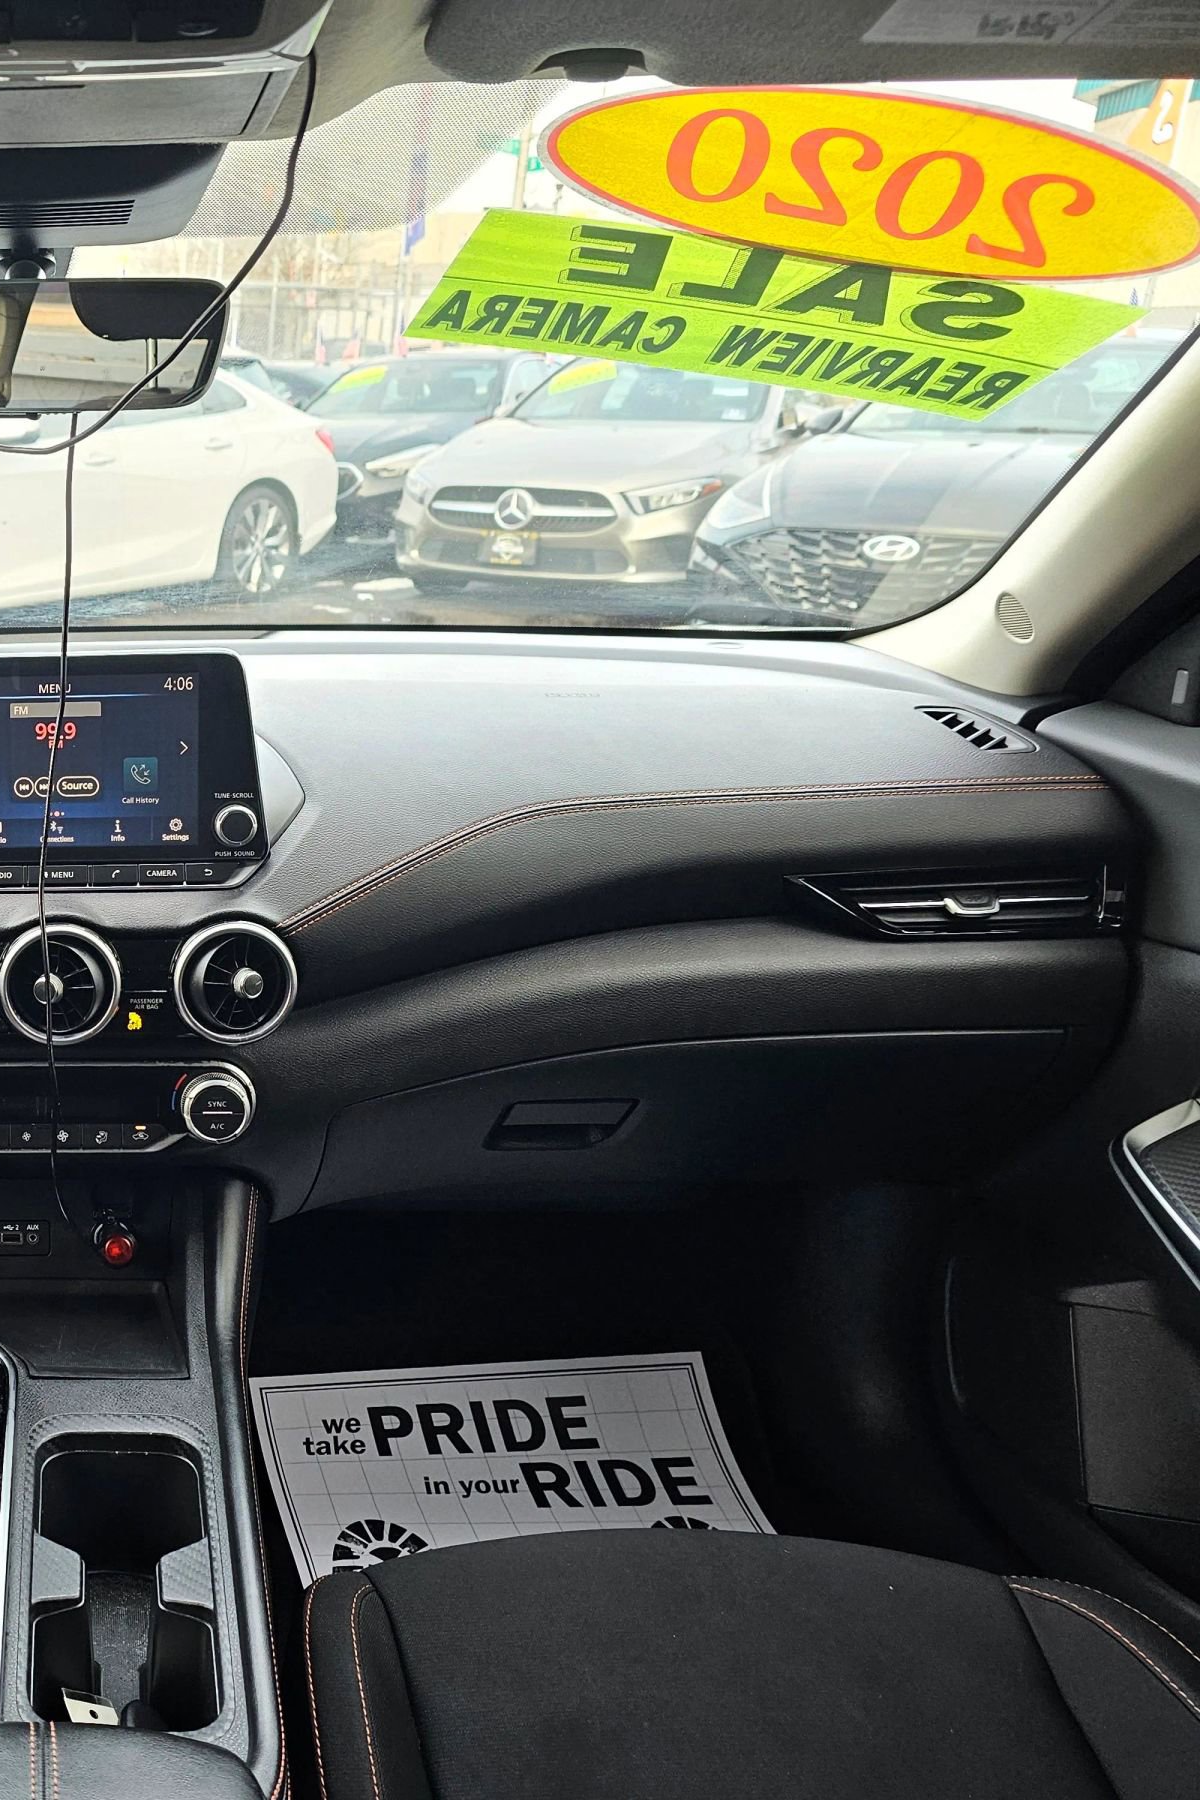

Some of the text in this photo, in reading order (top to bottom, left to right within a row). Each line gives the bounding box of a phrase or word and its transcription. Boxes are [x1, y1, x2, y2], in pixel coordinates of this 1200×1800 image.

[163, 676, 194, 691] 4:06
[13, 706, 29, 716] FM
[34, 722, 77, 741] 99.9
[61, 780, 94, 791] Source
[121, 796, 160, 805] Call History
[39, 835, 75, 843] Cnnections
[110, 834, 126, 842] Info
[162, 833, 190, 843] Settings
[50, 870, 74, 879] MENU
[146, 868, 178, 878] CAMERA
[207, 1100, 228, 1108] SYNC
[321, 1417, 361, 1434] we
[366, 1396, 600, 1457] PRIDE
[302, 1435, 366, 1456] take
[423, 1456, 714, 1508] in your RIDE
